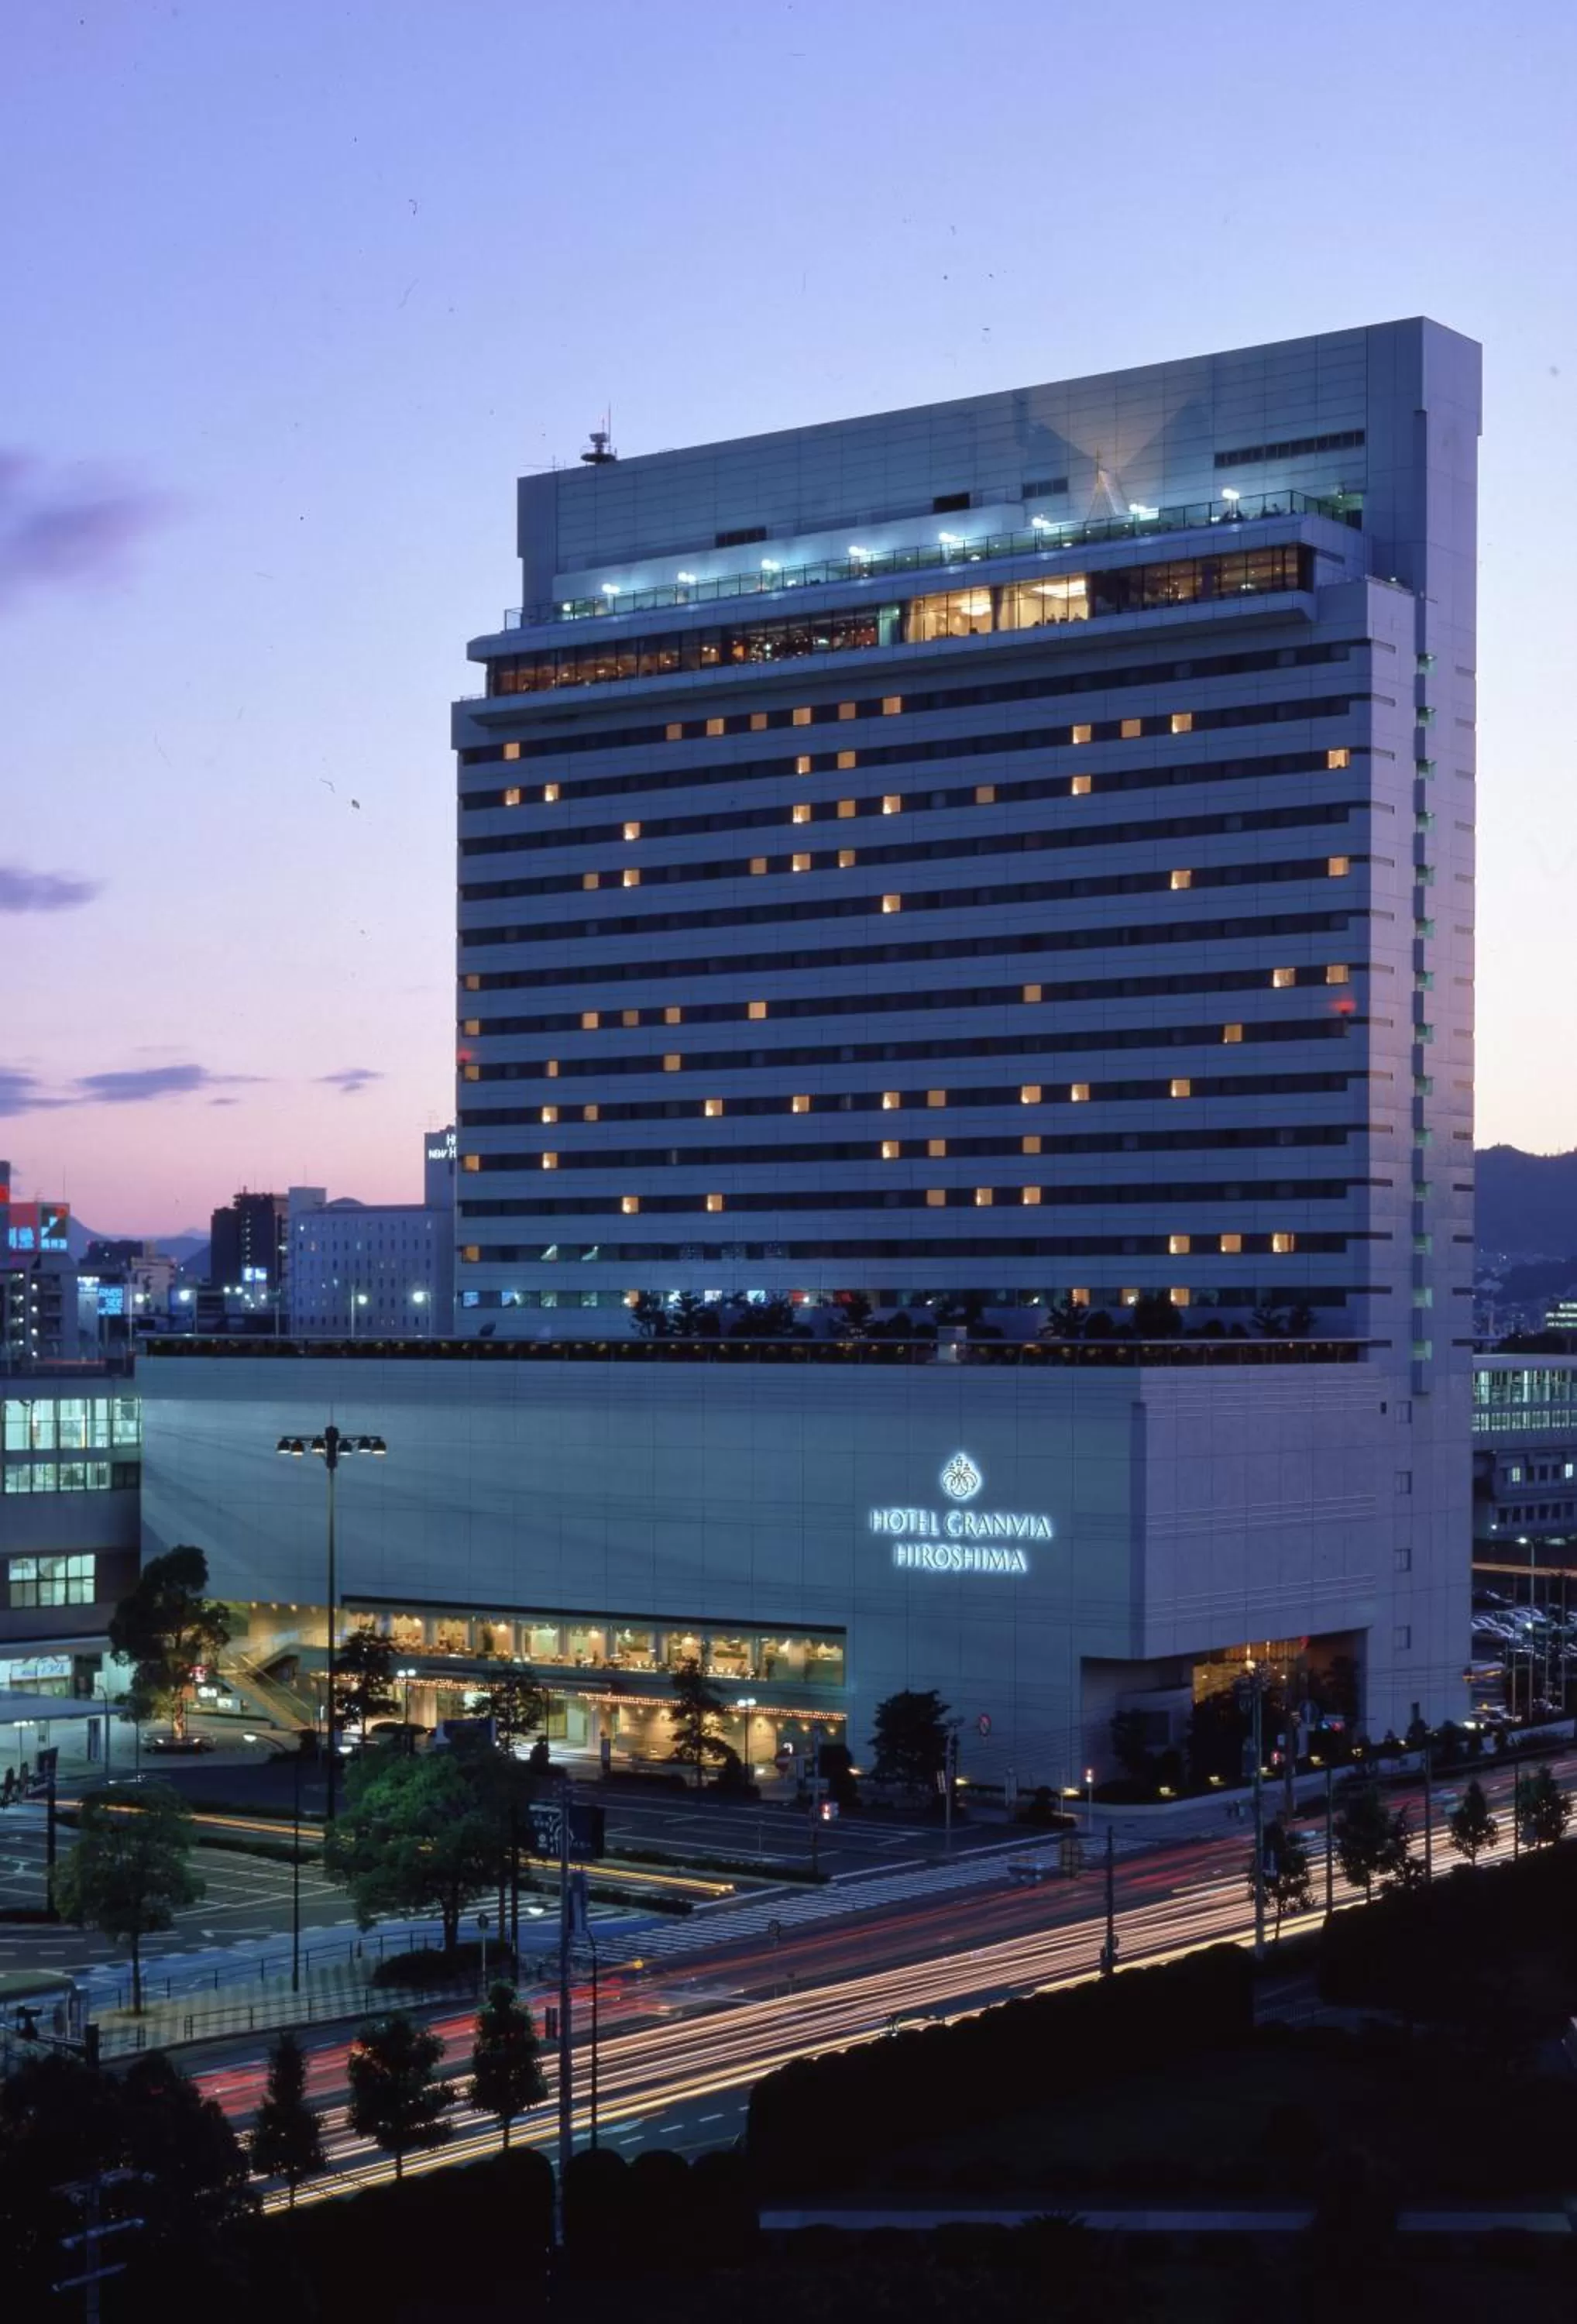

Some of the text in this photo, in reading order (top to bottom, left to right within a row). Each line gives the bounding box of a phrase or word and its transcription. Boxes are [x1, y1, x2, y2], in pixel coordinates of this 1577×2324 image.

[428, 1148, 448, 1160] NEW
[870, 1508, 1053, 1539] HOTEL GRANVIA
[894, 1542, 1027, 1573] HIROSHIMA
